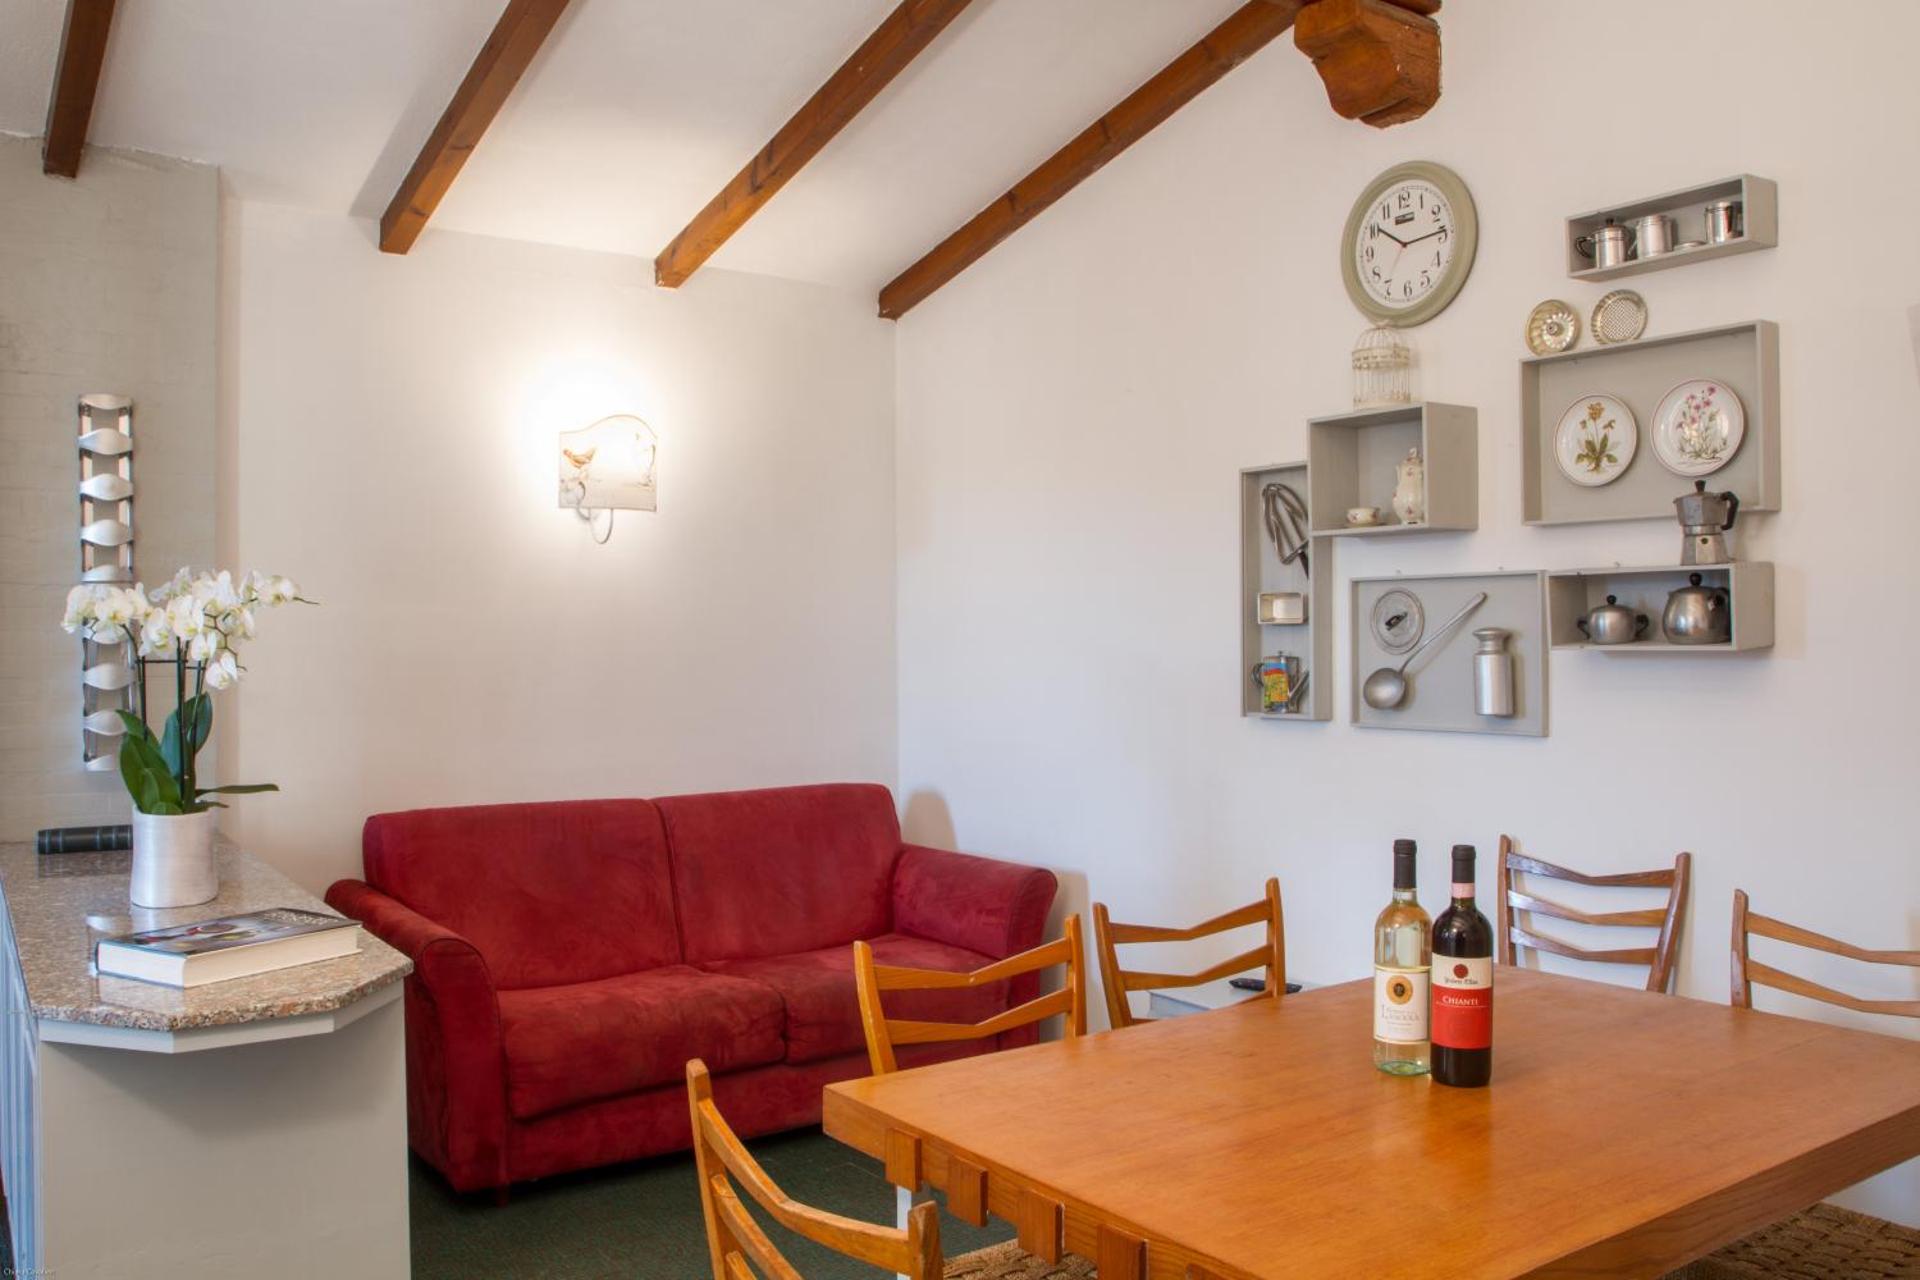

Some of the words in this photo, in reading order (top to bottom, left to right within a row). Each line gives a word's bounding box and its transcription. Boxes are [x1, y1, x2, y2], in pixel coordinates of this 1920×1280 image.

[1398, 190, 1410, 210] 12
[1420, 192, 1424, 210] 1
[1383, 203, 1390, 220] 11
[1431, 205, 1441, 223] 2
[1365, 246, 1374, 263] 9
[1431, 250, 1441, 268] 4
[1372, 265, 1381, 281] 8
[1420, 270, 1431, 289] 5
[1384, 278, 1393, 297] 7
[1403, 280, 1412, 297] 6
[1442, 996, 1479, 1006] CHIANTI
